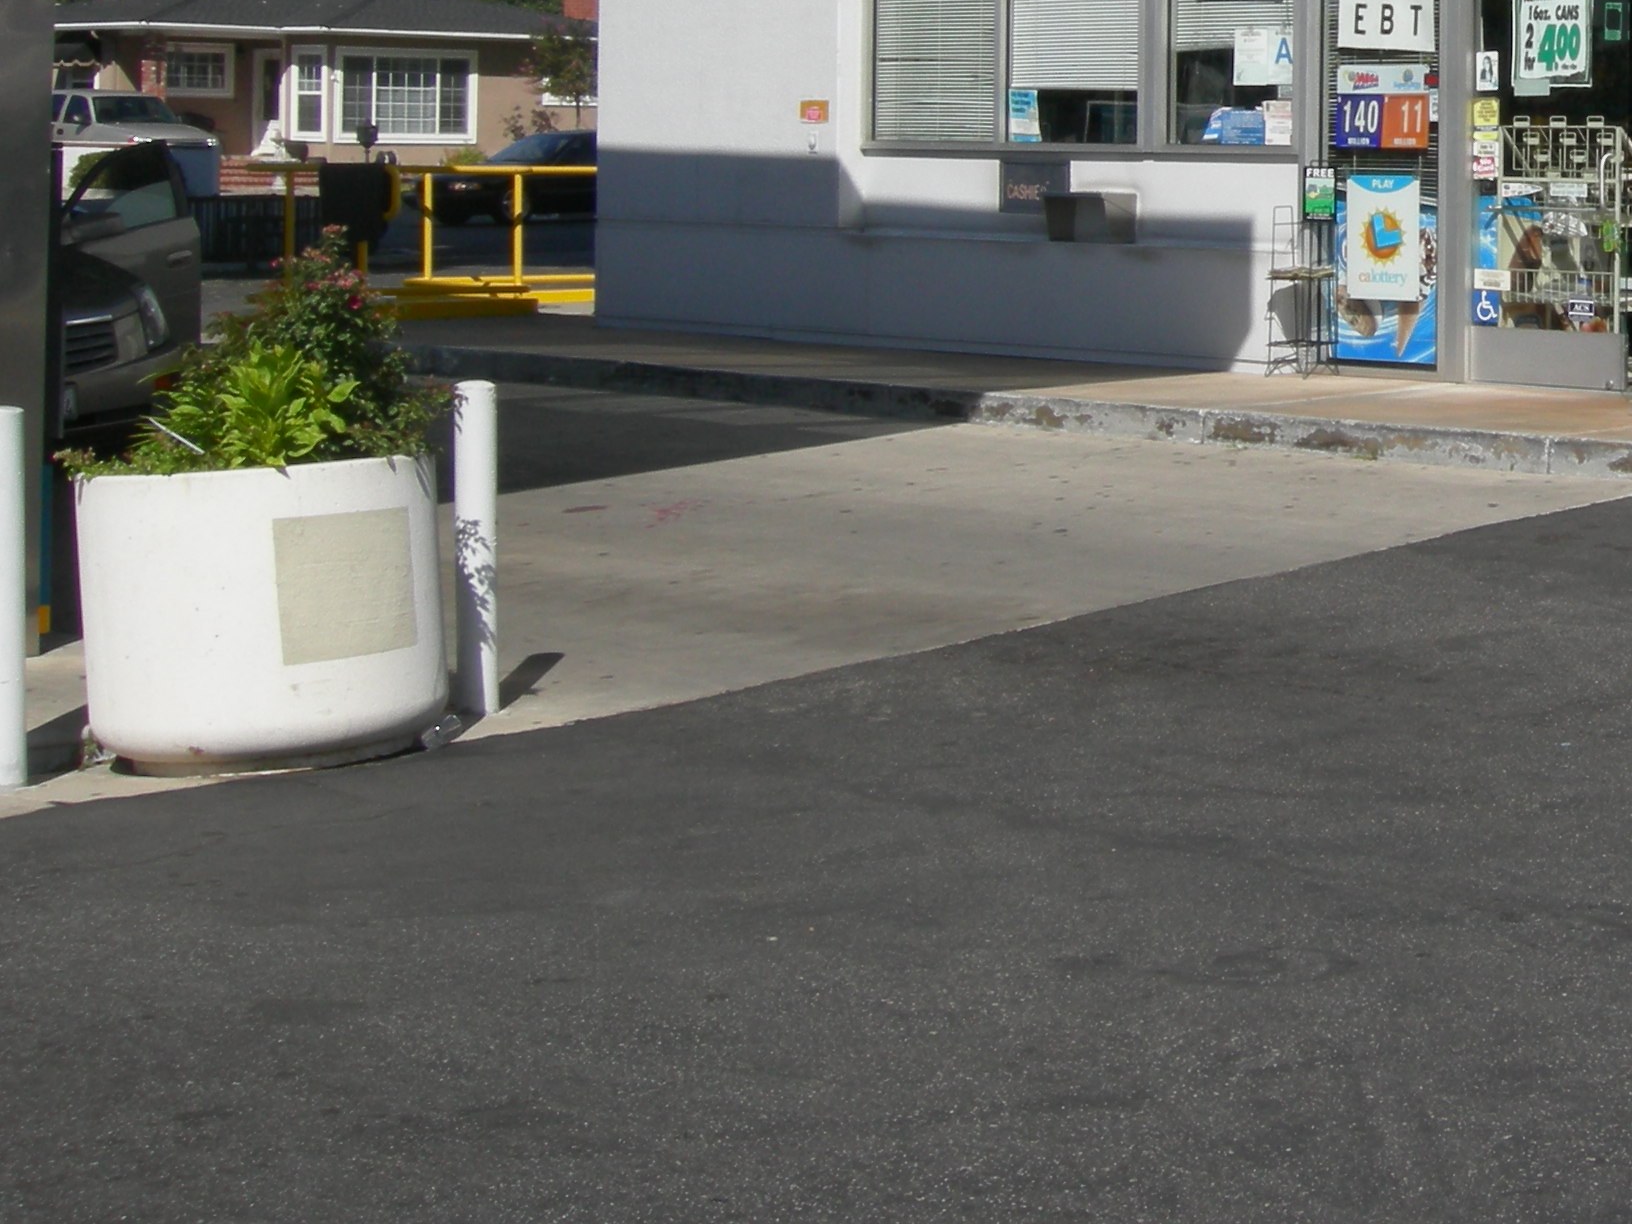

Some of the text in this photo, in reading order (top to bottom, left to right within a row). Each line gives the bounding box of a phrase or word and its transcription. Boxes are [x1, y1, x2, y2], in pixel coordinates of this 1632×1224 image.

[1354, 3, 1422, 35] EBT
[1529, 5, 1579, 21] 16oz. CANS
[1525, 23, 1534, 49] 2
[1275, 37, 1293, 64] A
[1524, 51, 1536, 71] for
[1343, 100, 1379, 133] 140
[1401, 100, 1422, 133] 11
[1306, 168, 1335, 178] FREE
[1372, 179, 1393, 188] PLAY
[1573, 303, 1590, 312] ACS
